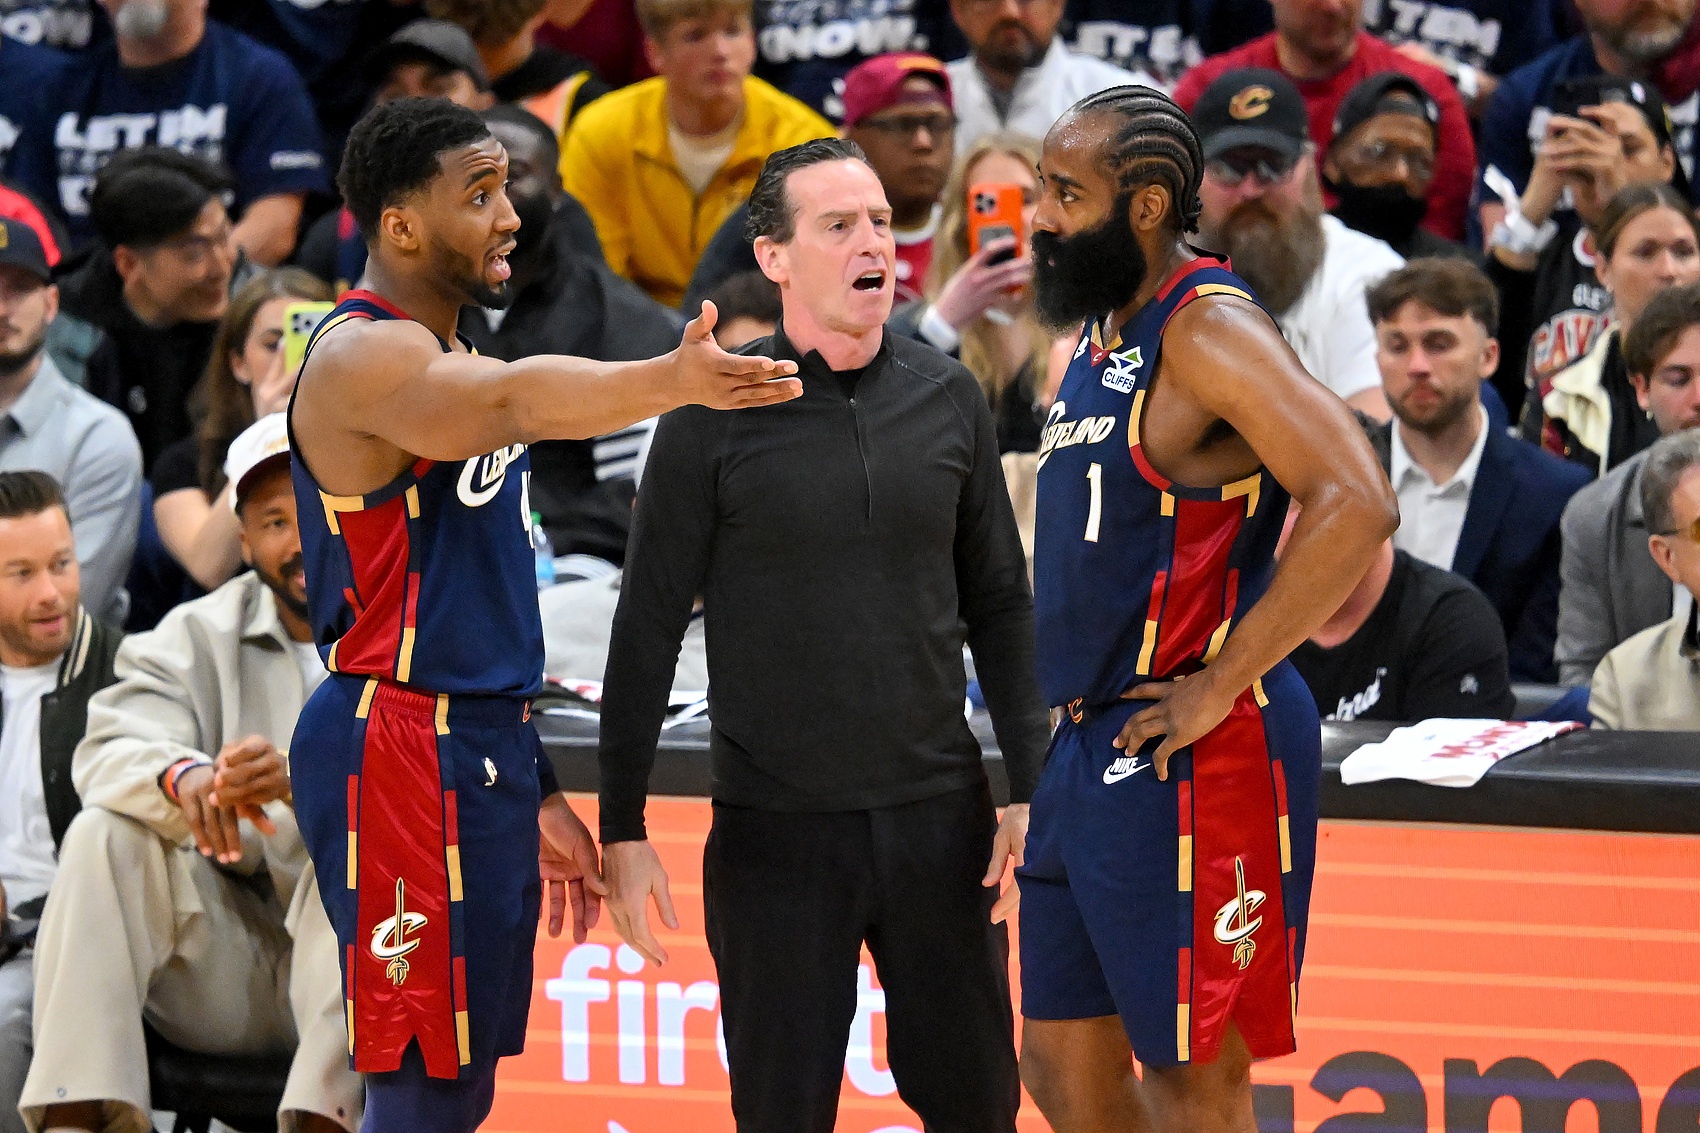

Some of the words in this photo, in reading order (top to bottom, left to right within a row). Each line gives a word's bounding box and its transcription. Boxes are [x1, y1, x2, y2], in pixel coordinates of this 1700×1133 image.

[1104, 371, 1134, 390] CLIFFS
[1083, 462, 1102, 543] 1
[1110, 757, 1139, 773] NIKE
[545, 943, 898, 1096] firt
